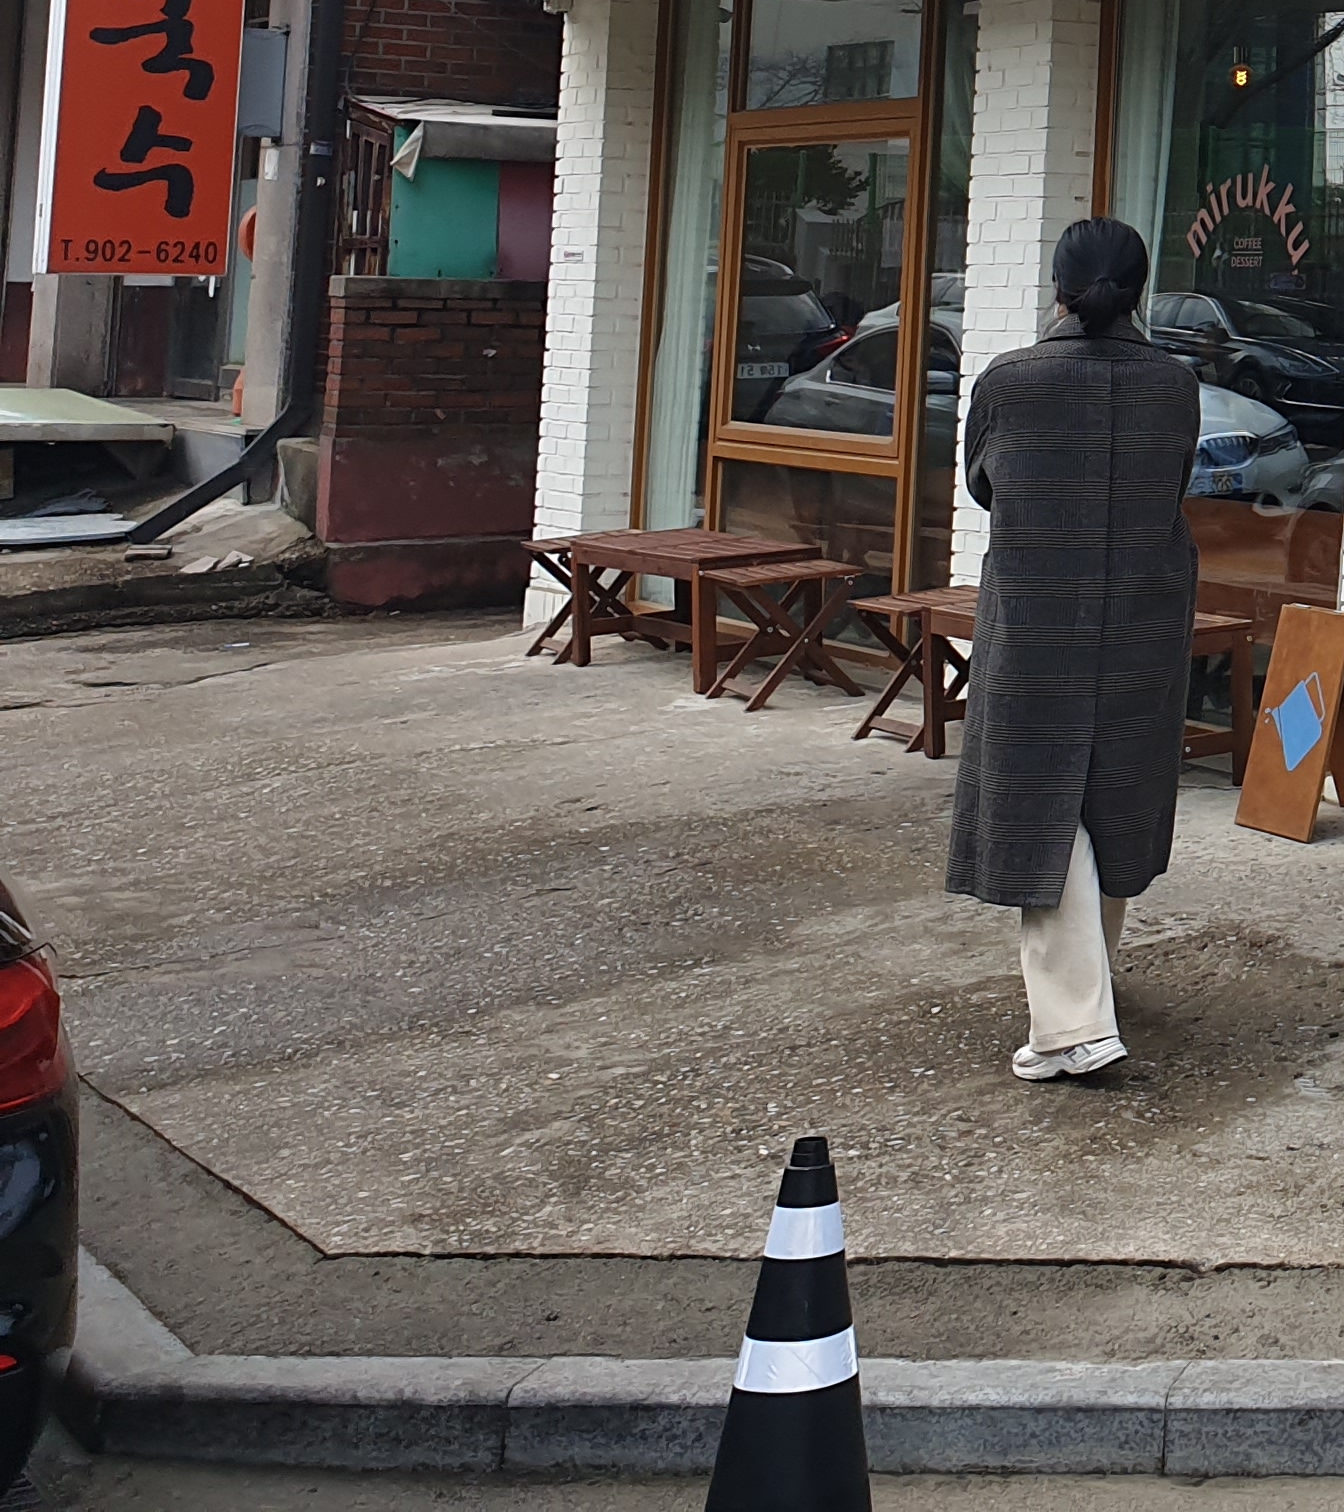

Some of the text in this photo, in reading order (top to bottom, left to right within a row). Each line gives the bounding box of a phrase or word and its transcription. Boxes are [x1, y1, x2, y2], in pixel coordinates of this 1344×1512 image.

[1234, 237, 1262, 249] COFFEE
[60, 238, 218, 265] T.902-6240
[1231, 256, 1263, 267] DESSERT
